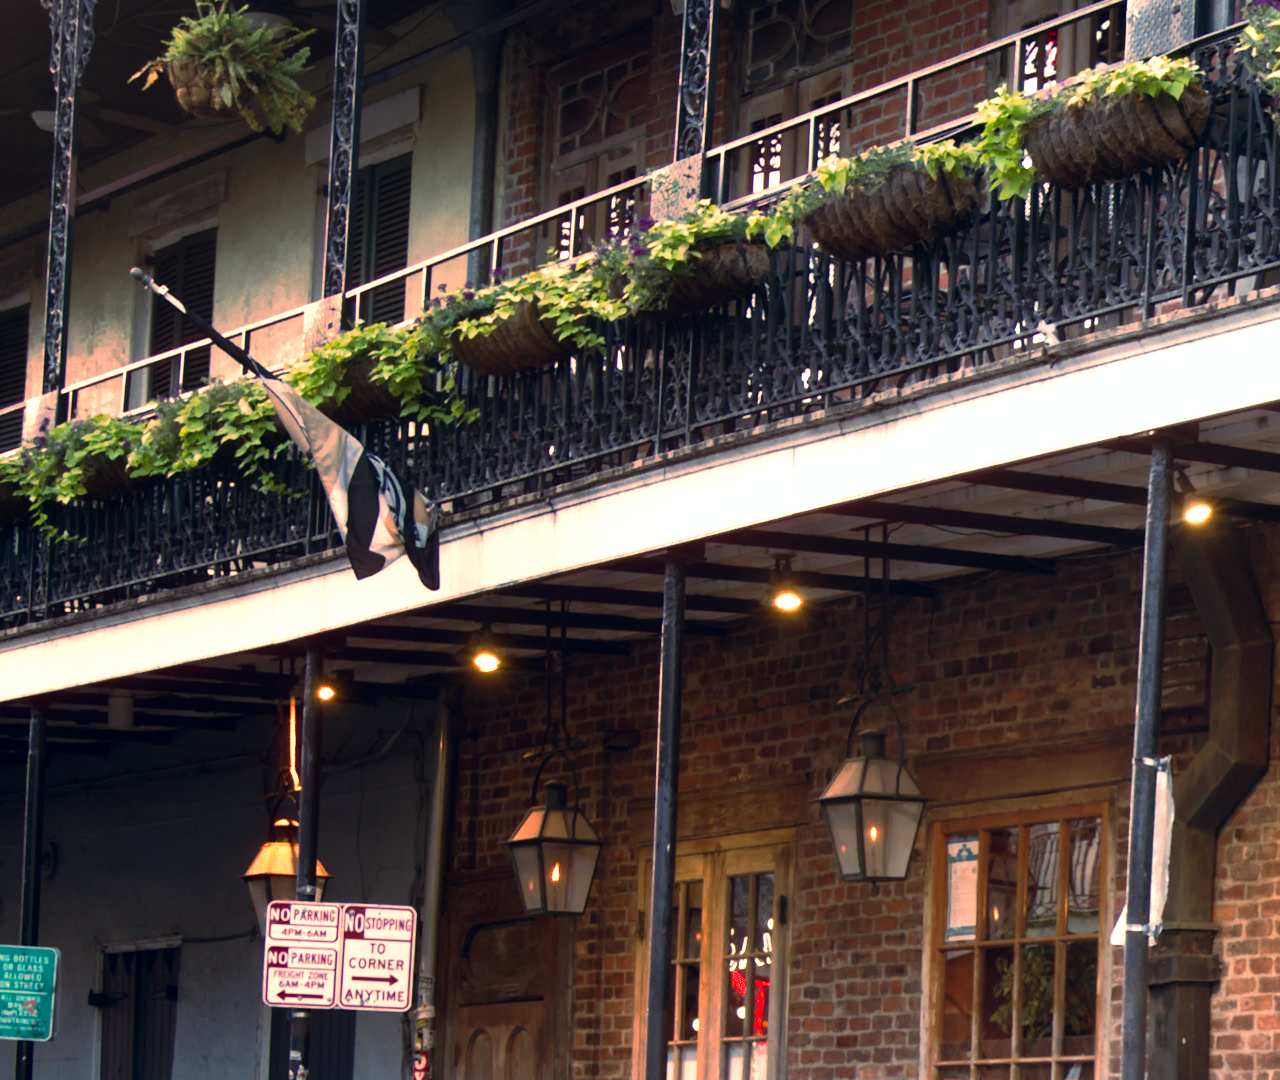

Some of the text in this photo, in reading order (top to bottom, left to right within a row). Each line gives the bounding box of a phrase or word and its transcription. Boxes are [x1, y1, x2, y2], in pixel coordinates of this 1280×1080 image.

[270, 907, 336, 922] NO PARKING
[345, 912, 411, 933] NO STOPPING
[281, 927, 327, 938] 4PM-6AM
[369, 942, 386, 955] TO
[14, 954, 49, 965] BOTTLES
[267, 950, 333, 966] NO PARKING
[348, 957, 405, 971] CORNER
[4, 972, 41, 982] ALLOWED
[273, 970, 328, 980] FREIGHT ZONE
[278, 979, 325, 989] 6AM-4PM
[344, 988, 405, 1002] ANYTIME
